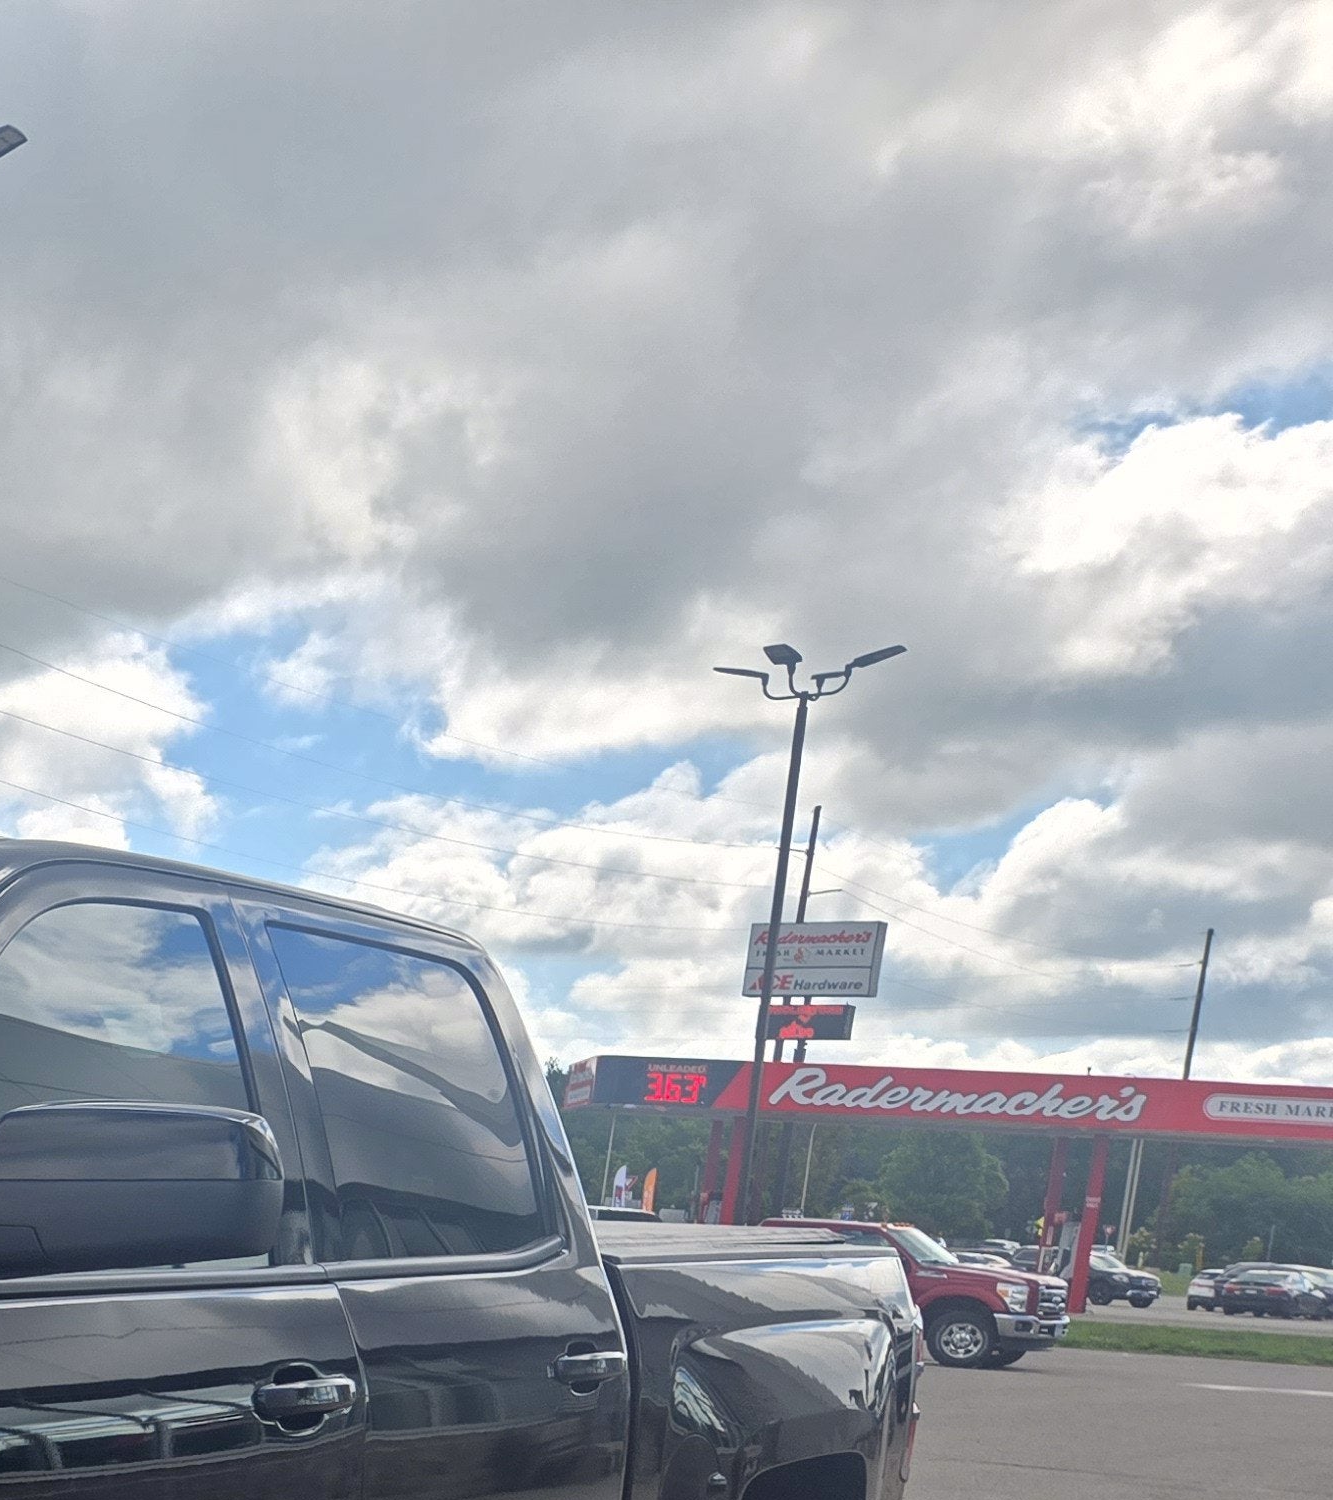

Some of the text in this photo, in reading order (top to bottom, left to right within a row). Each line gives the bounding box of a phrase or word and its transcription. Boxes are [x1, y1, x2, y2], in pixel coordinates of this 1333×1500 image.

[815, 948, 865, 957] MARKET
[793, 979, 863, 991] Hardware
[648, 1063, 707, 1074] UNLEADED
[769, 1067, 1147, 1121] Radermacher's
[1219, 1100, 1278, 1116] FRESH
